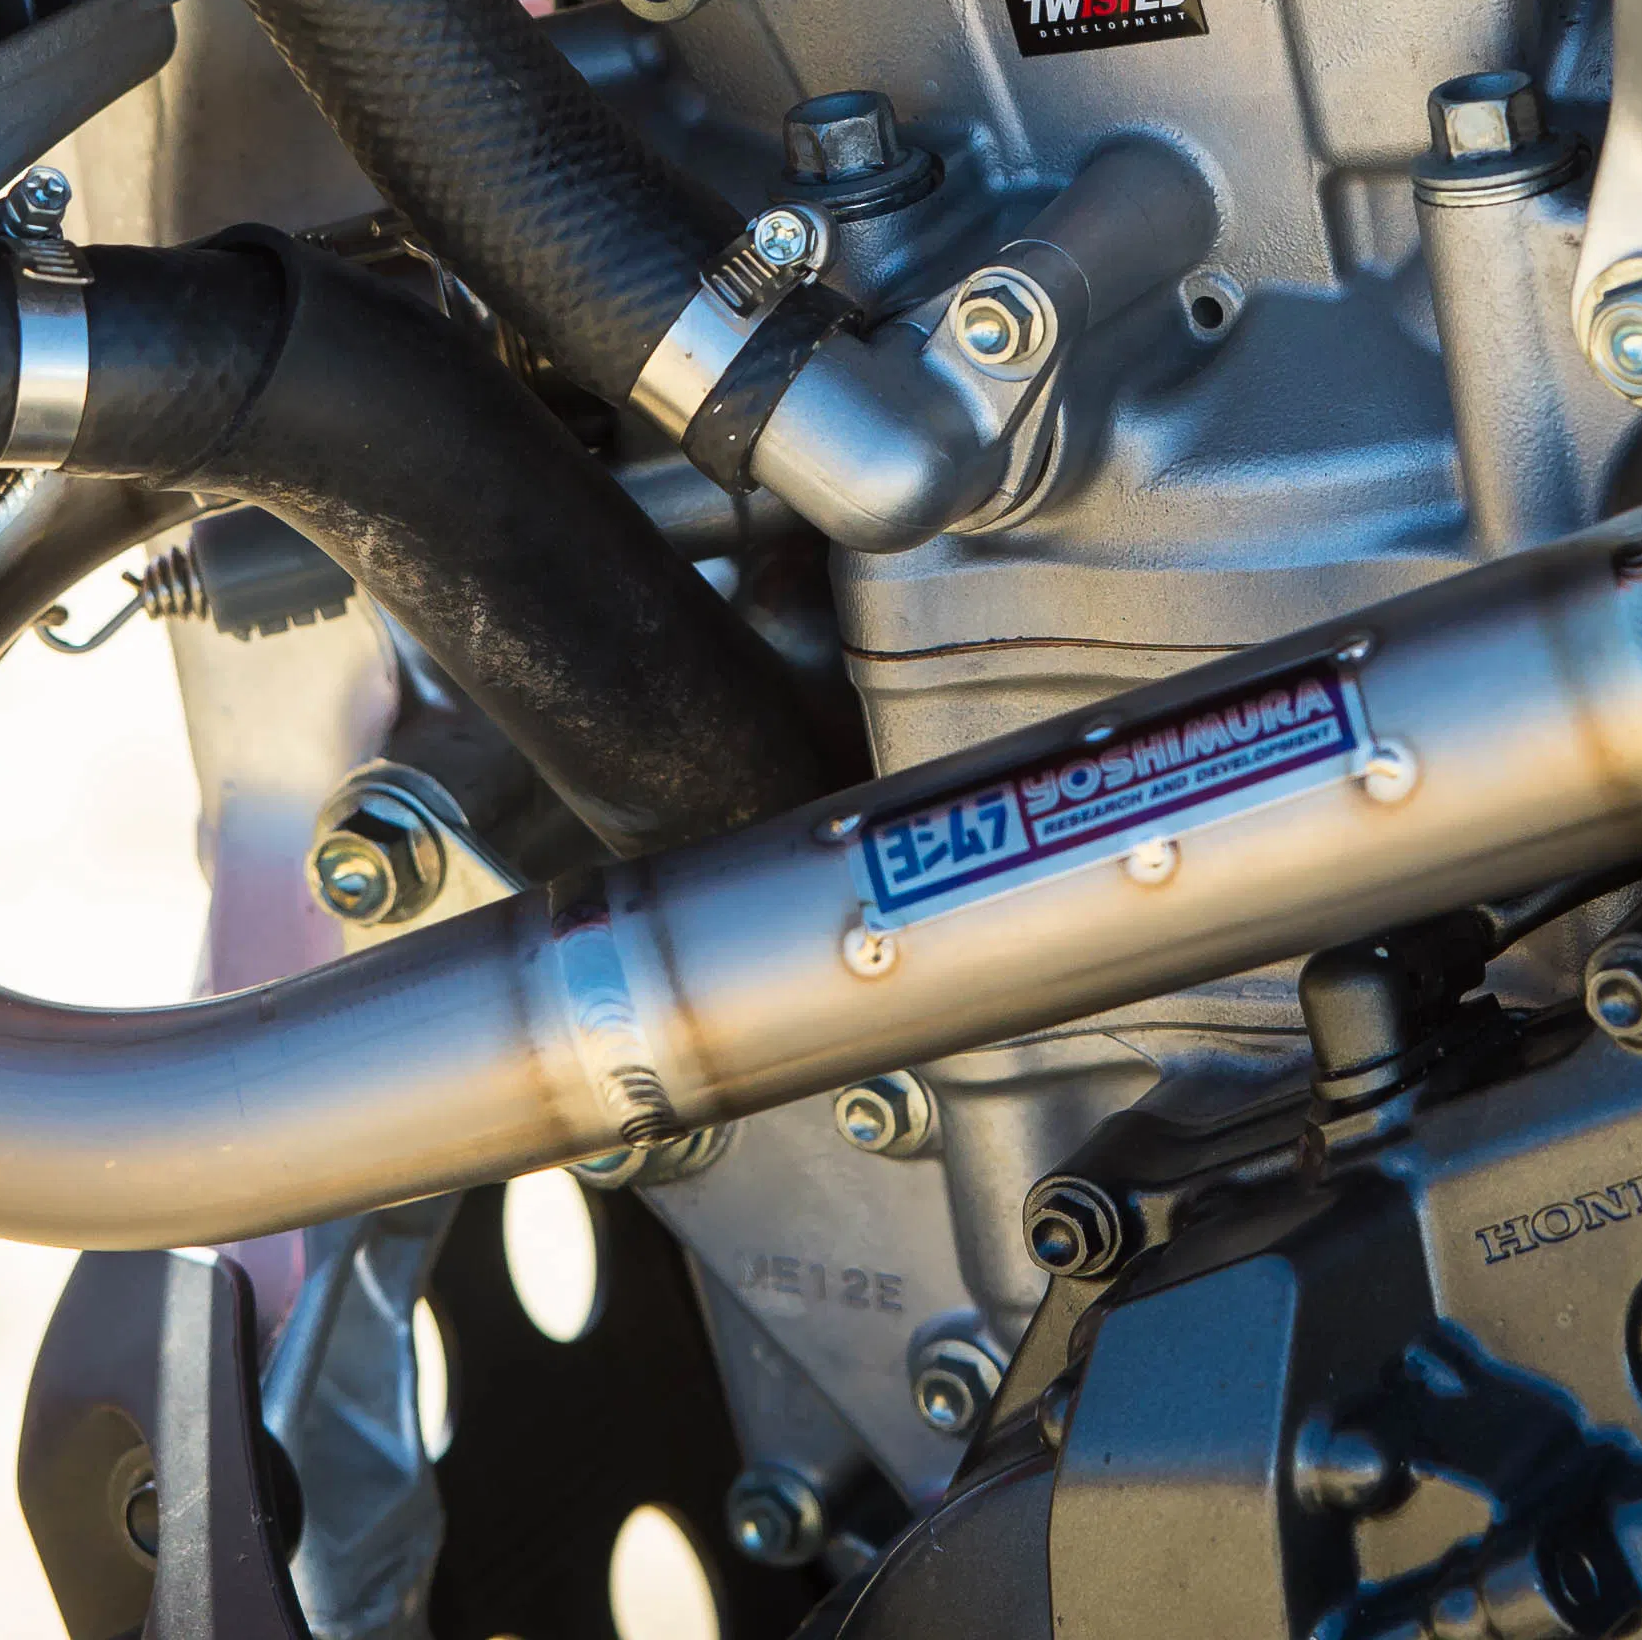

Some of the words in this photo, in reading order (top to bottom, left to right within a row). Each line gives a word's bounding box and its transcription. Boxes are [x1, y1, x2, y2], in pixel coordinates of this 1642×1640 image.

[1040, 11, 1186, 38] DEVELOPMENT
[1023, 678, 1334, 816] YOSHIMURA
[1042, 789, 1143, 836] RESEARCH
[1151, 772, 1189, 800] AND
[1197, 726, 1331, 782] DEVELOPMENT
